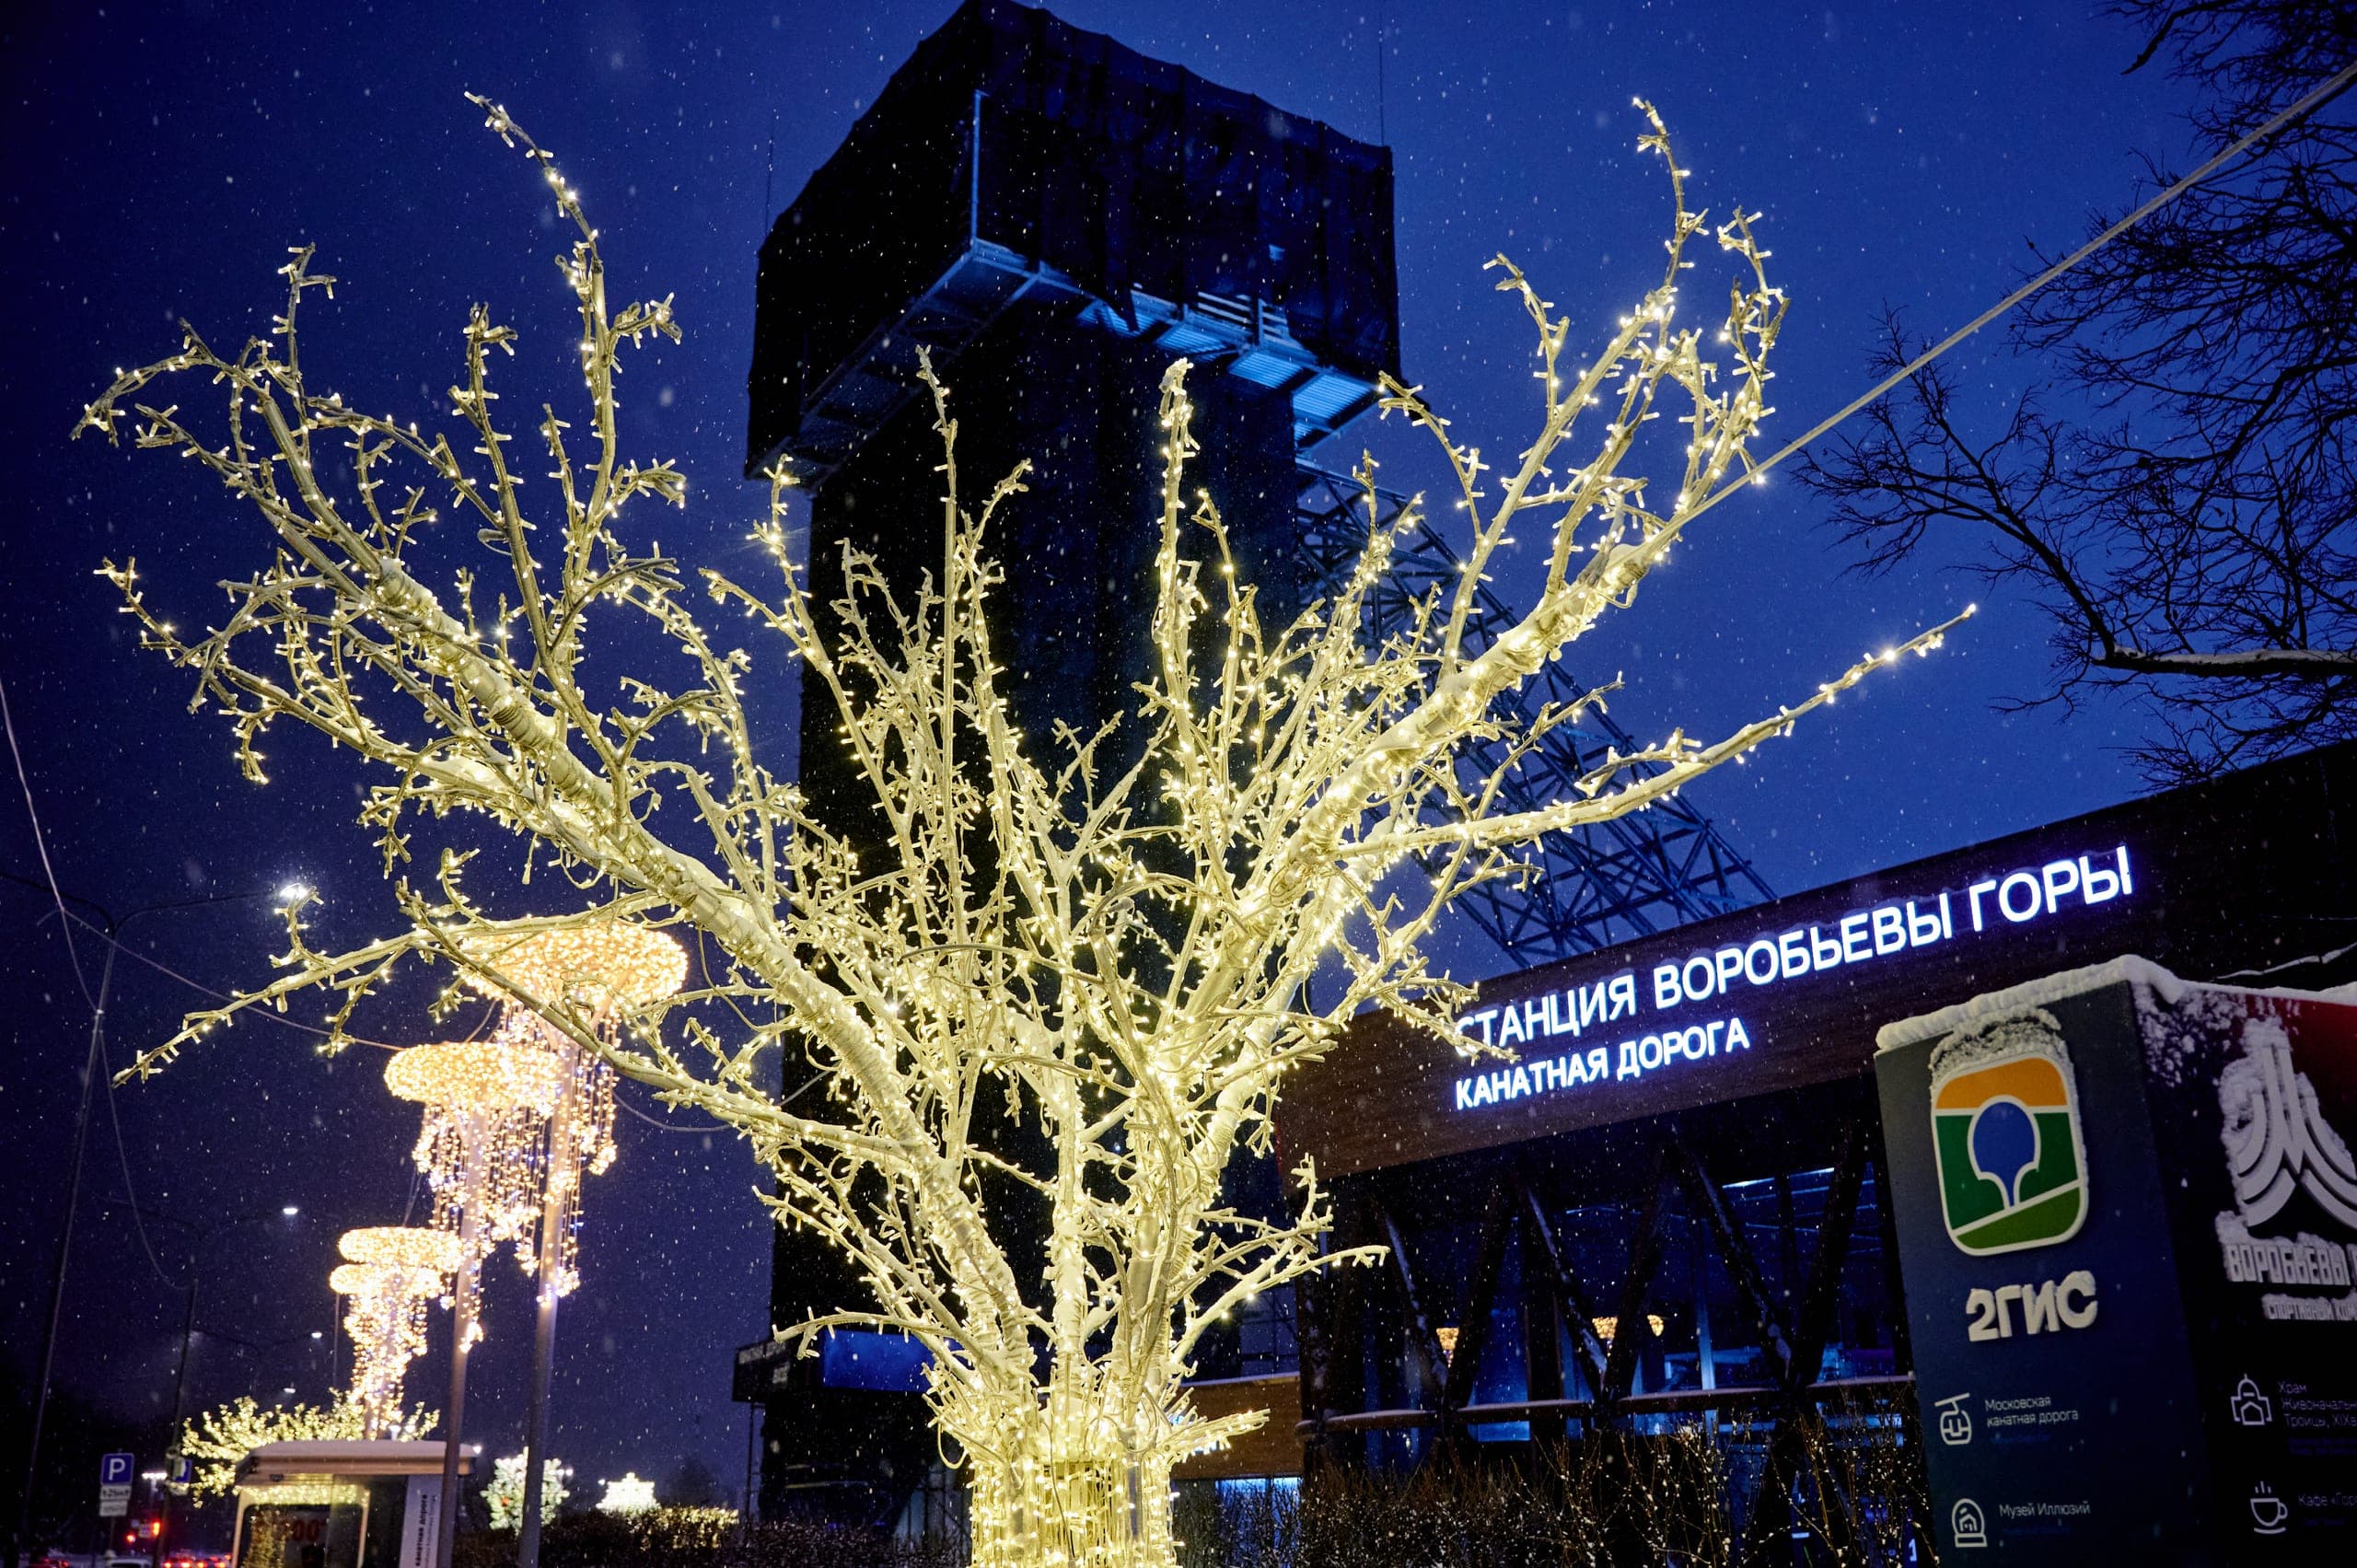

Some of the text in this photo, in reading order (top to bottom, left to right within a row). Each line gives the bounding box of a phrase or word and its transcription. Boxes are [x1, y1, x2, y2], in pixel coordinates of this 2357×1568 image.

[1454, 844, 2133, 1057] СТАНЦИЯ ВОРОБЬЕВЫ ГОРЫ
[1455, 1016, 1750, 1110] КАНАТНАЯ ДОРОГА
[1966, 1272, 2099, 1342] 2ГИС
[2278, 1381, 2307, 1395] Храм
[1984, 1396, 2052, 1412] Московская
[1986, 1409, 2080, 1428] канатная дорога
[107, 1458, 126, 1481] P
[1998, 1499, 2092, 1520] Музей Иллюзий
[2297, 1492, 2328, 1508] Кафе
